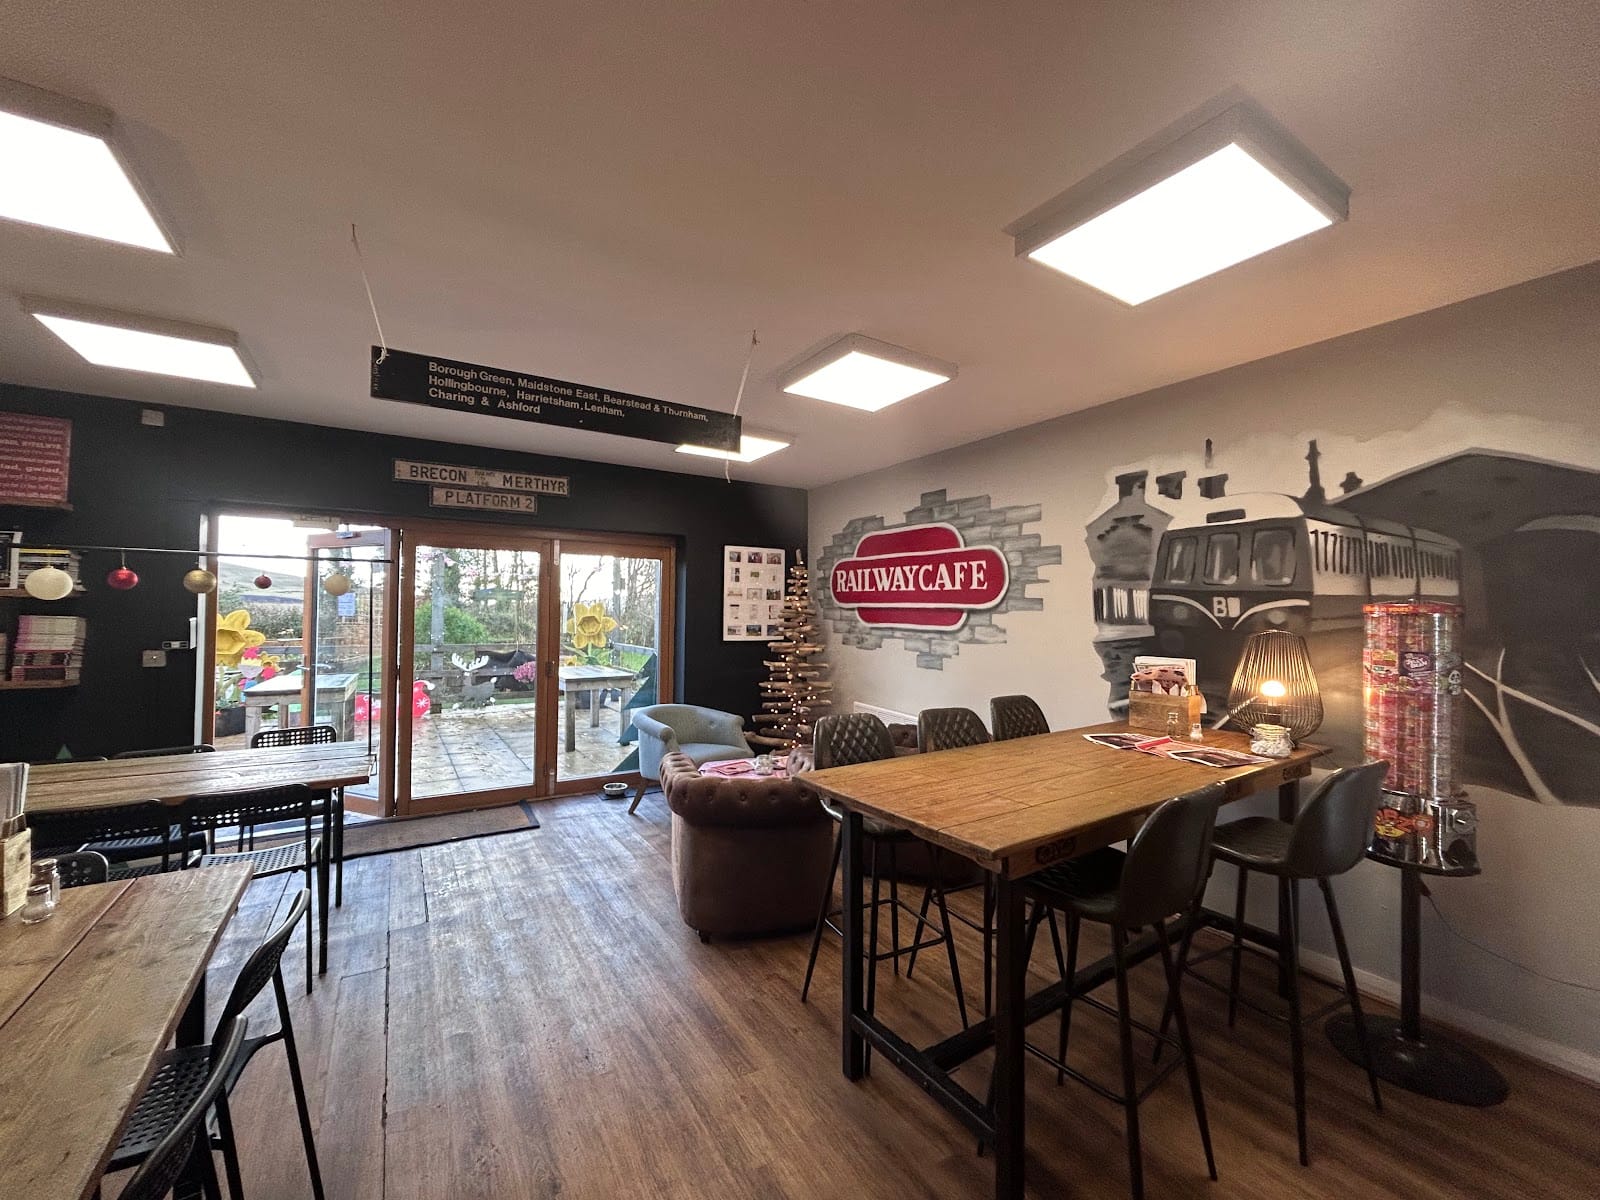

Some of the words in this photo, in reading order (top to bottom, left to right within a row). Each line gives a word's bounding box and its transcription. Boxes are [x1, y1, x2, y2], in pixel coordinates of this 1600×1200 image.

[428, 375, 510, 398] Hollingbourne,
[428, 362, 478, 380] Borough
[479, 371, 515, 387] Green,
[518, 378, 573, 396] Maidstone
[576, 389, 601, 402] East,
[604, 394, 651, 411] Bearstead
[653, 404, 661, 412] &
[428, 388, 475, 405] Charing
[480, 396, 490, 406] &
[497, 400, 541, 414] Ashford
[410, 465, 467, 482] BRECON
[502, 475, 566, 493] MERTHYR
[445, 491, 520, 509] PLATFORM
[525, 499, 533, 508] 2
